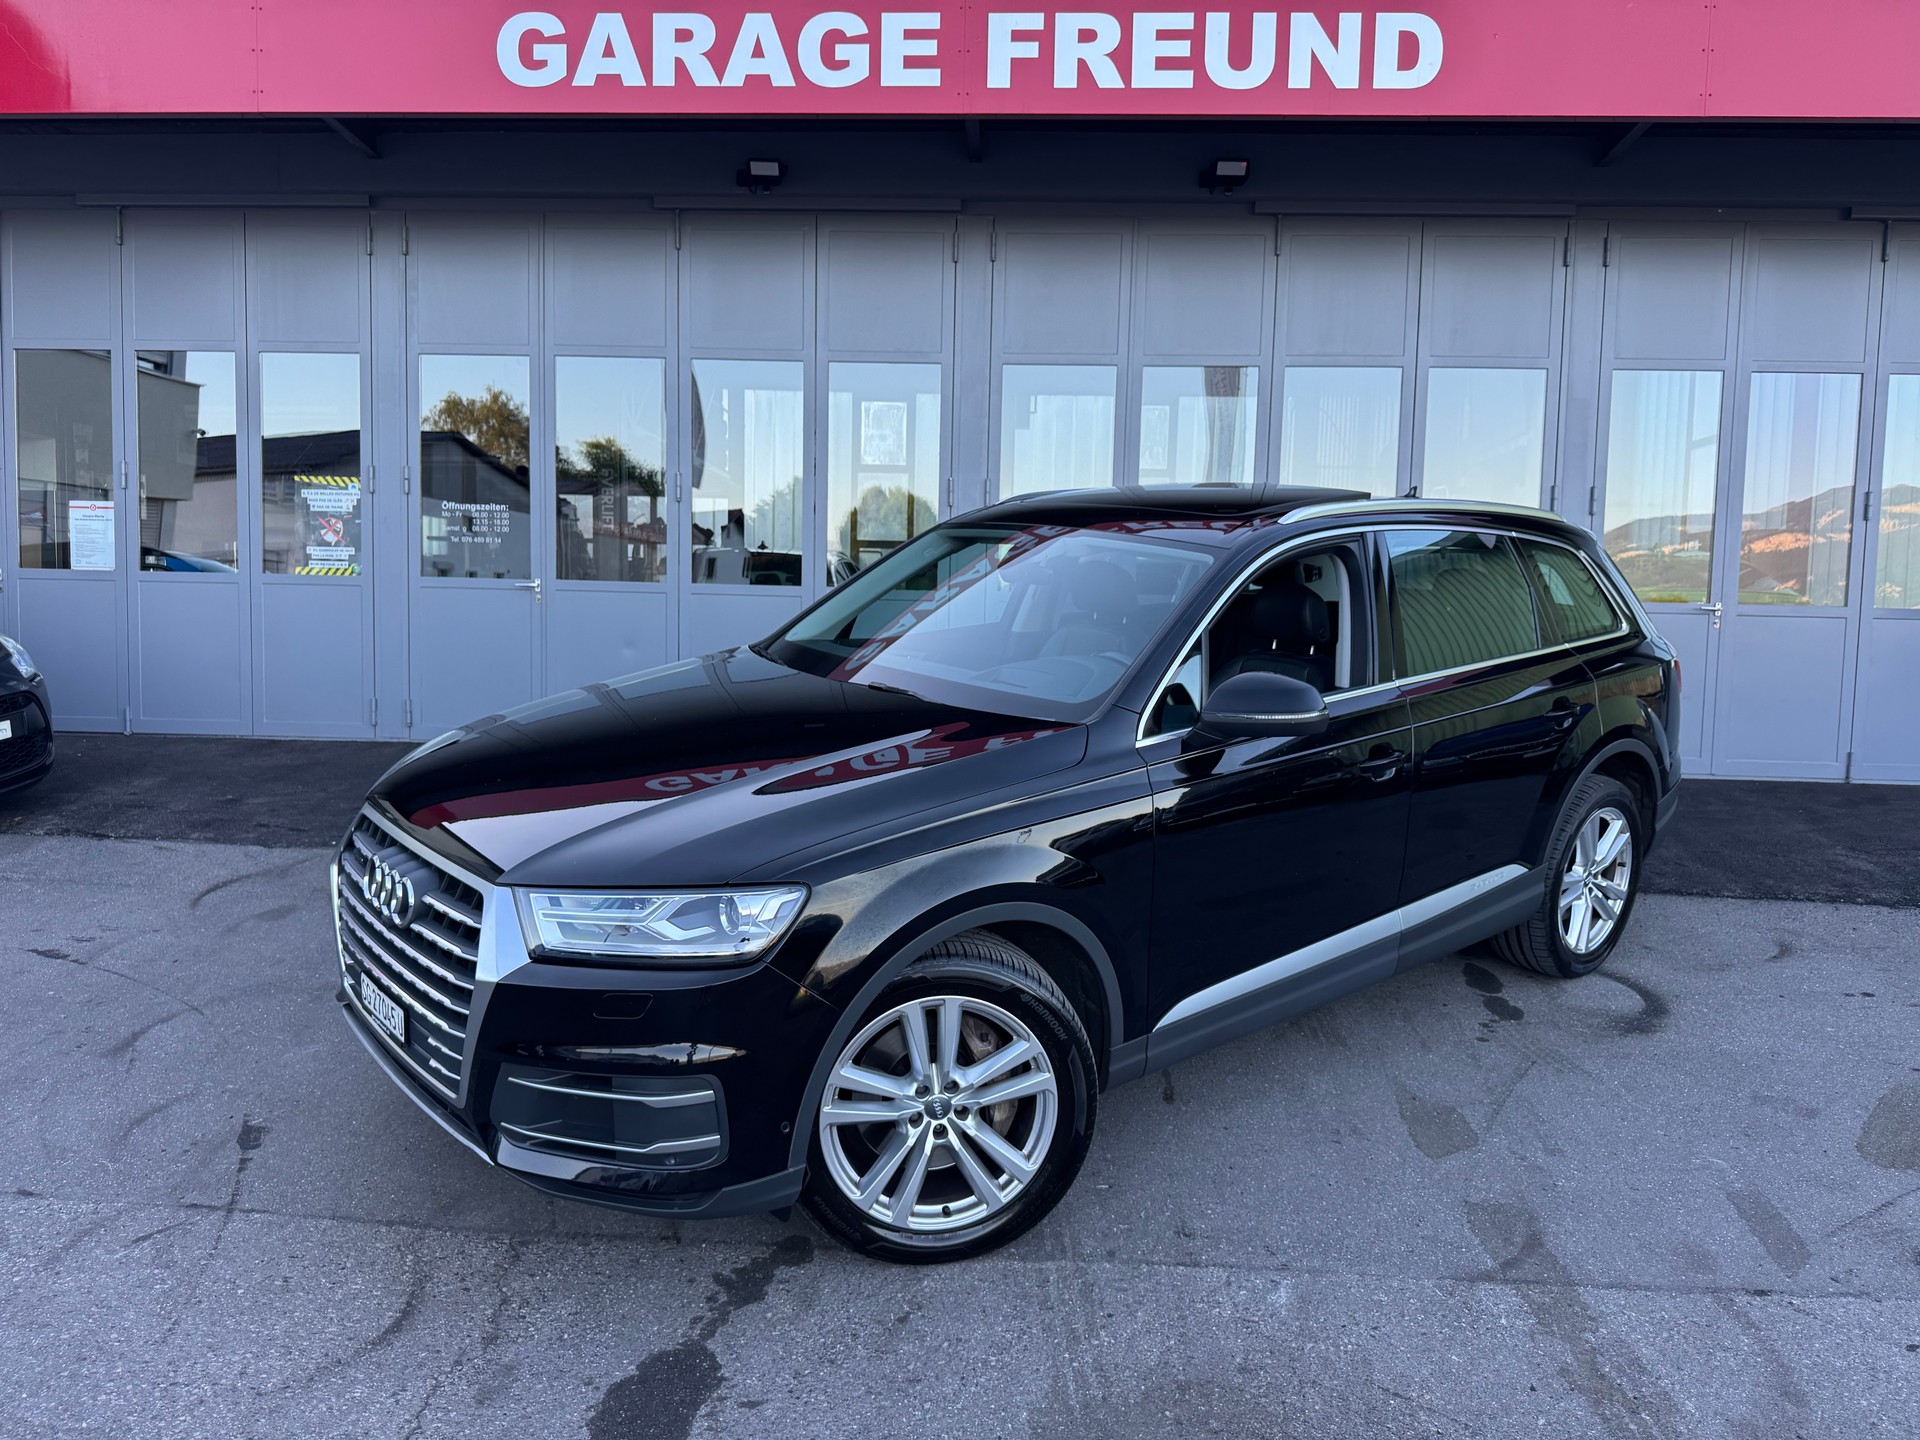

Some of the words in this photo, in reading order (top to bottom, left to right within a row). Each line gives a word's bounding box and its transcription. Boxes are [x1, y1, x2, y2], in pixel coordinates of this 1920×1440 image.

[496, 11, 941, 88] GARAGE
[987, 12, 1444, 90] FREUND
[442, 500, 509, 512] Öffnungszeiten:
